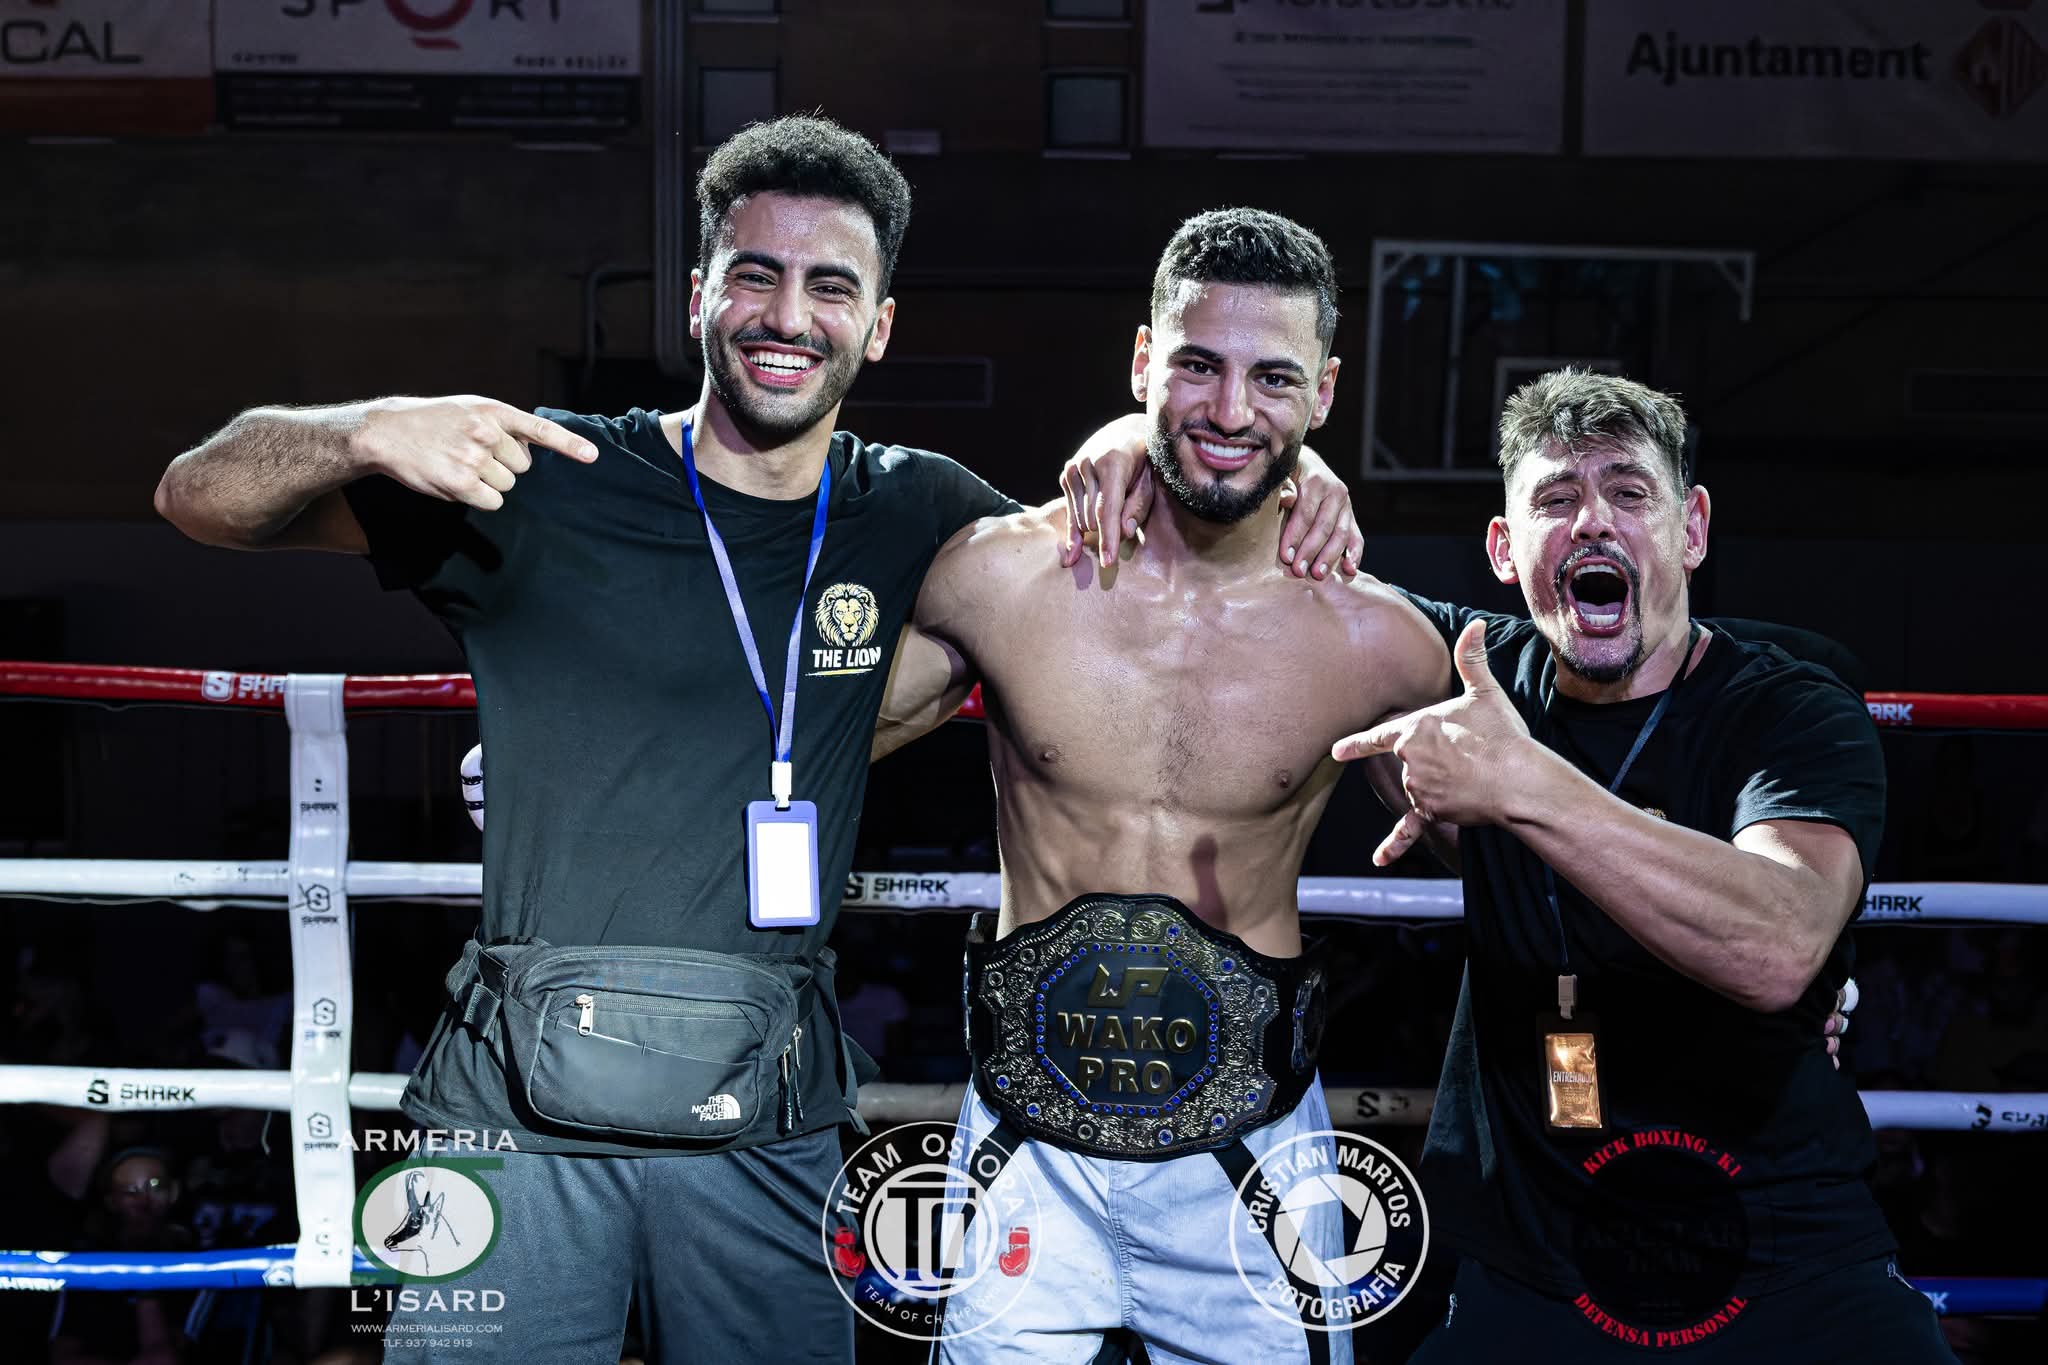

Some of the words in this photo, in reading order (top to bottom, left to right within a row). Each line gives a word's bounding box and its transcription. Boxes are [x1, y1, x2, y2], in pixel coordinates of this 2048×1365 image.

[1627, 31, 1932, 87] Ajuntament
[812, 649, 843, 668] THE
[846, 646, 882, 668] LION
[238, 674, 287, 693] SHA
[873, 877, 950, 895] SHARK
[1057, 1011, 1197, 1055] WAKO
[1078, 1056, 1173, 1095] PRO
[120, 1083, 196, 1102] SHARK
[708, 1096, 724, 1105] THE
[691, 1104, 724, 1113] NORTH
[699, 1112, 724, 1121] FACE
